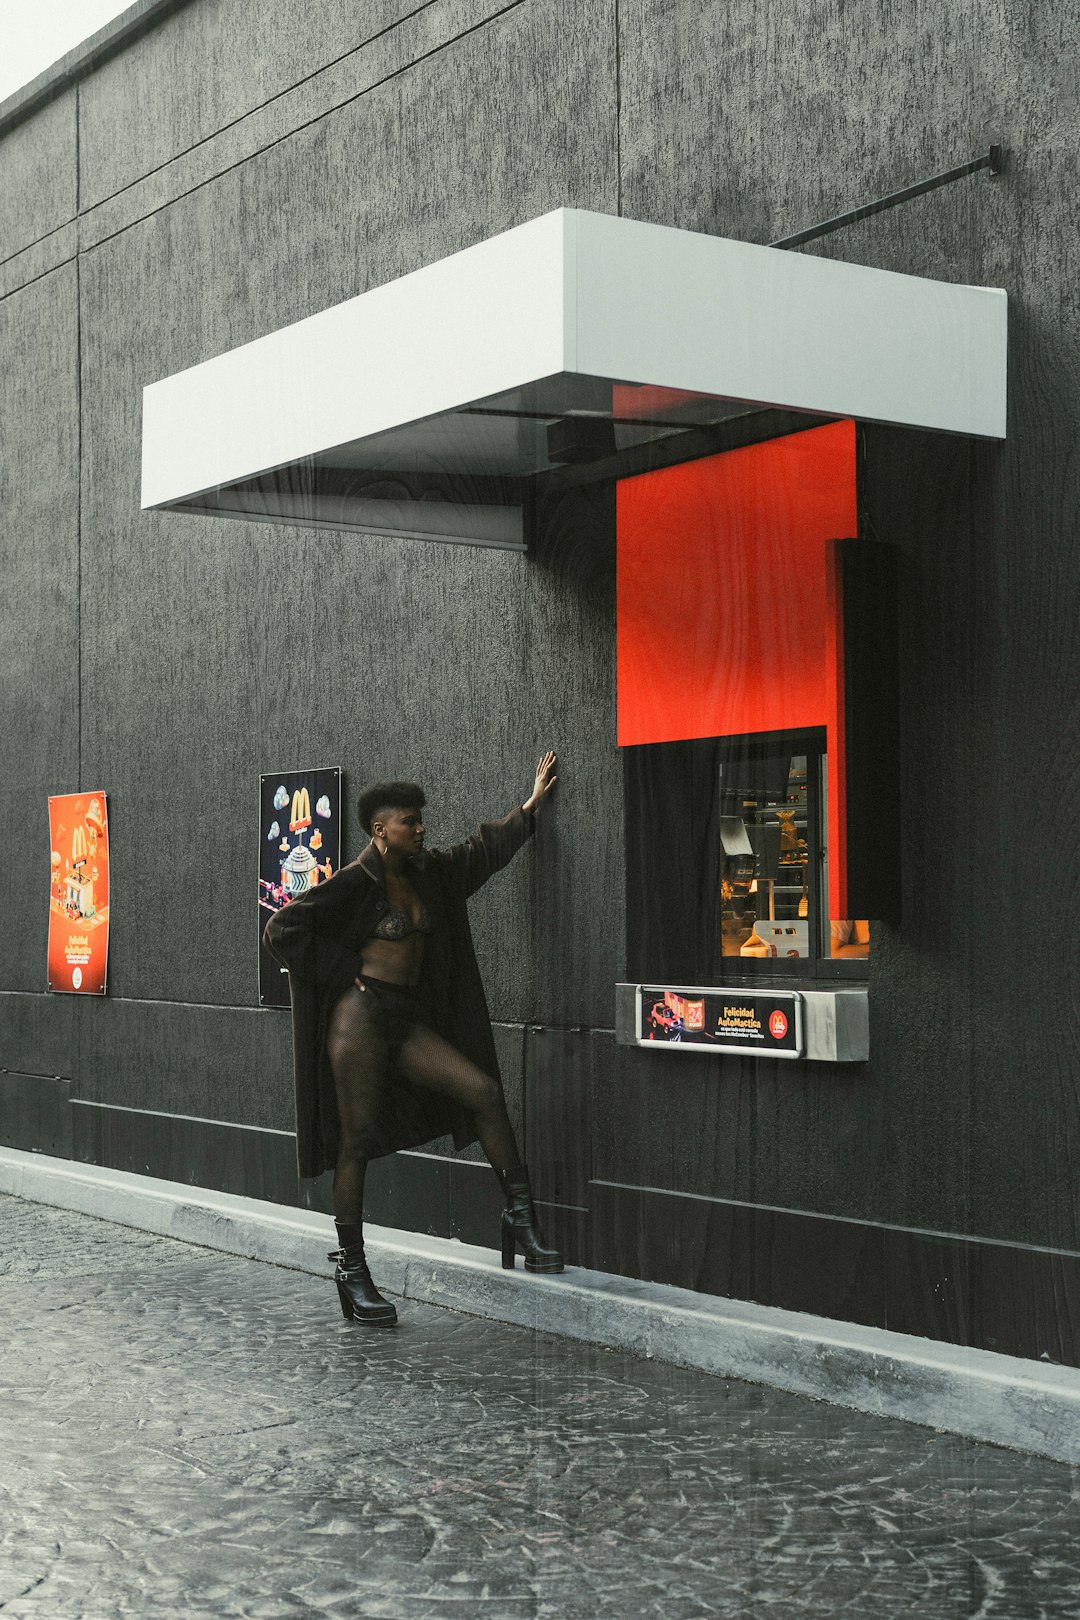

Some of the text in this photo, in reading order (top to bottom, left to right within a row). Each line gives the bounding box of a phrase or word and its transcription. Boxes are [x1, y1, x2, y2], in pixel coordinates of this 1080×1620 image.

[688, 1008, 702, 1022] 24
[724, 1007, 754, 1018] Felicidad
[718, 1017, 761, 1028] AutoMactica
